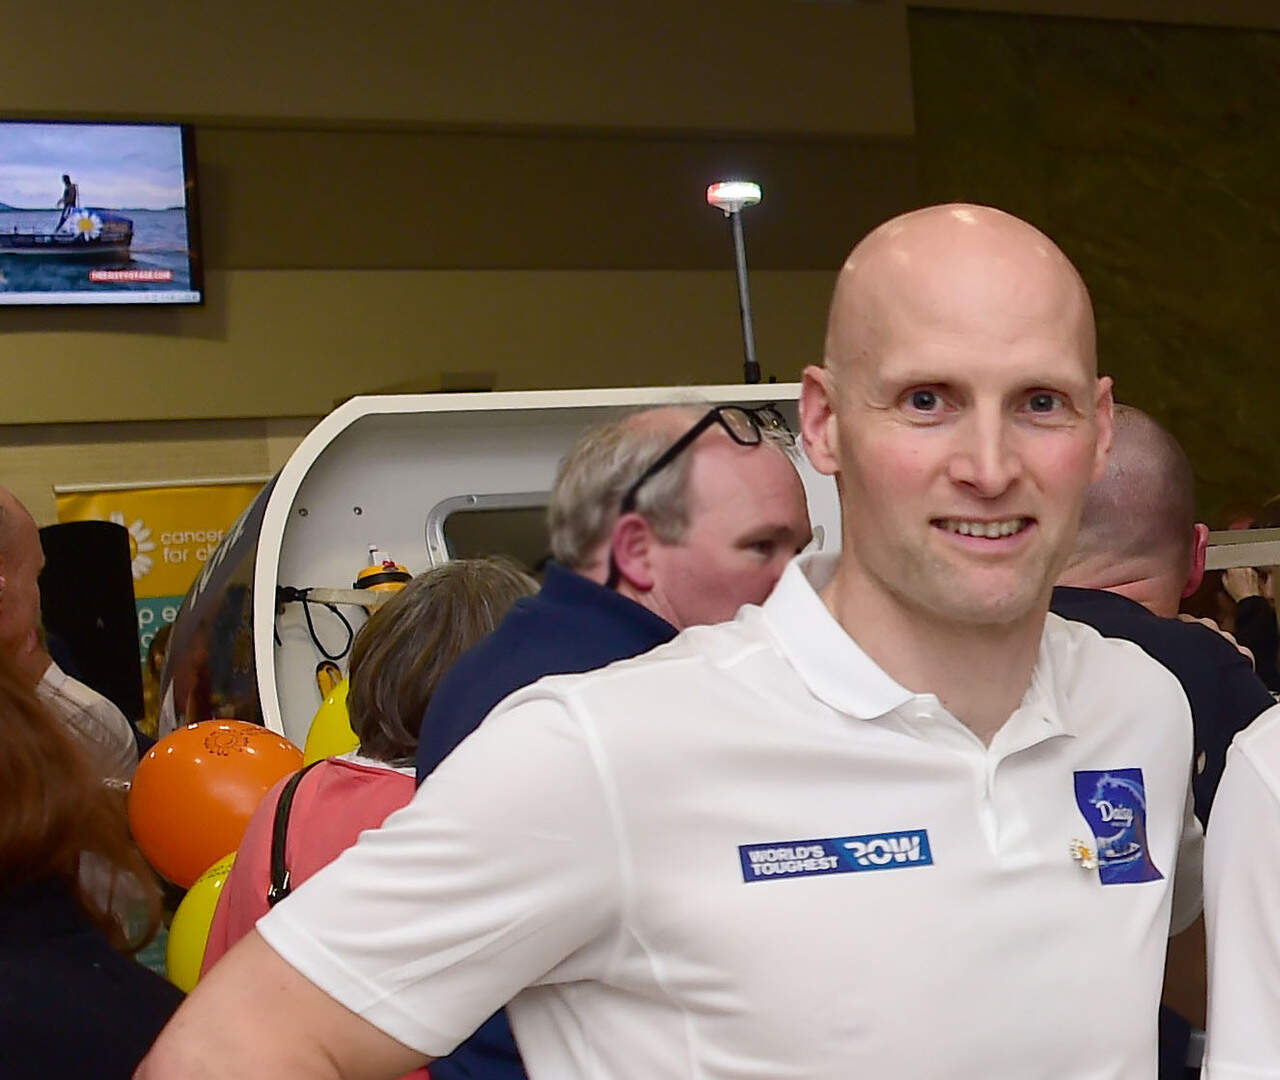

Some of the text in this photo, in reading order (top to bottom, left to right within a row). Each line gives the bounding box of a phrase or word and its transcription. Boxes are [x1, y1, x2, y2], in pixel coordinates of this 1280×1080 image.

[160, 528, 223, 545] cancer
[163, 548, 189, 563] for
[1095, 800, 1134, 828] Daisy
[748, 845, 825, 864] WORLD'S
[751, 855, 839, 876] TOUGHEST
